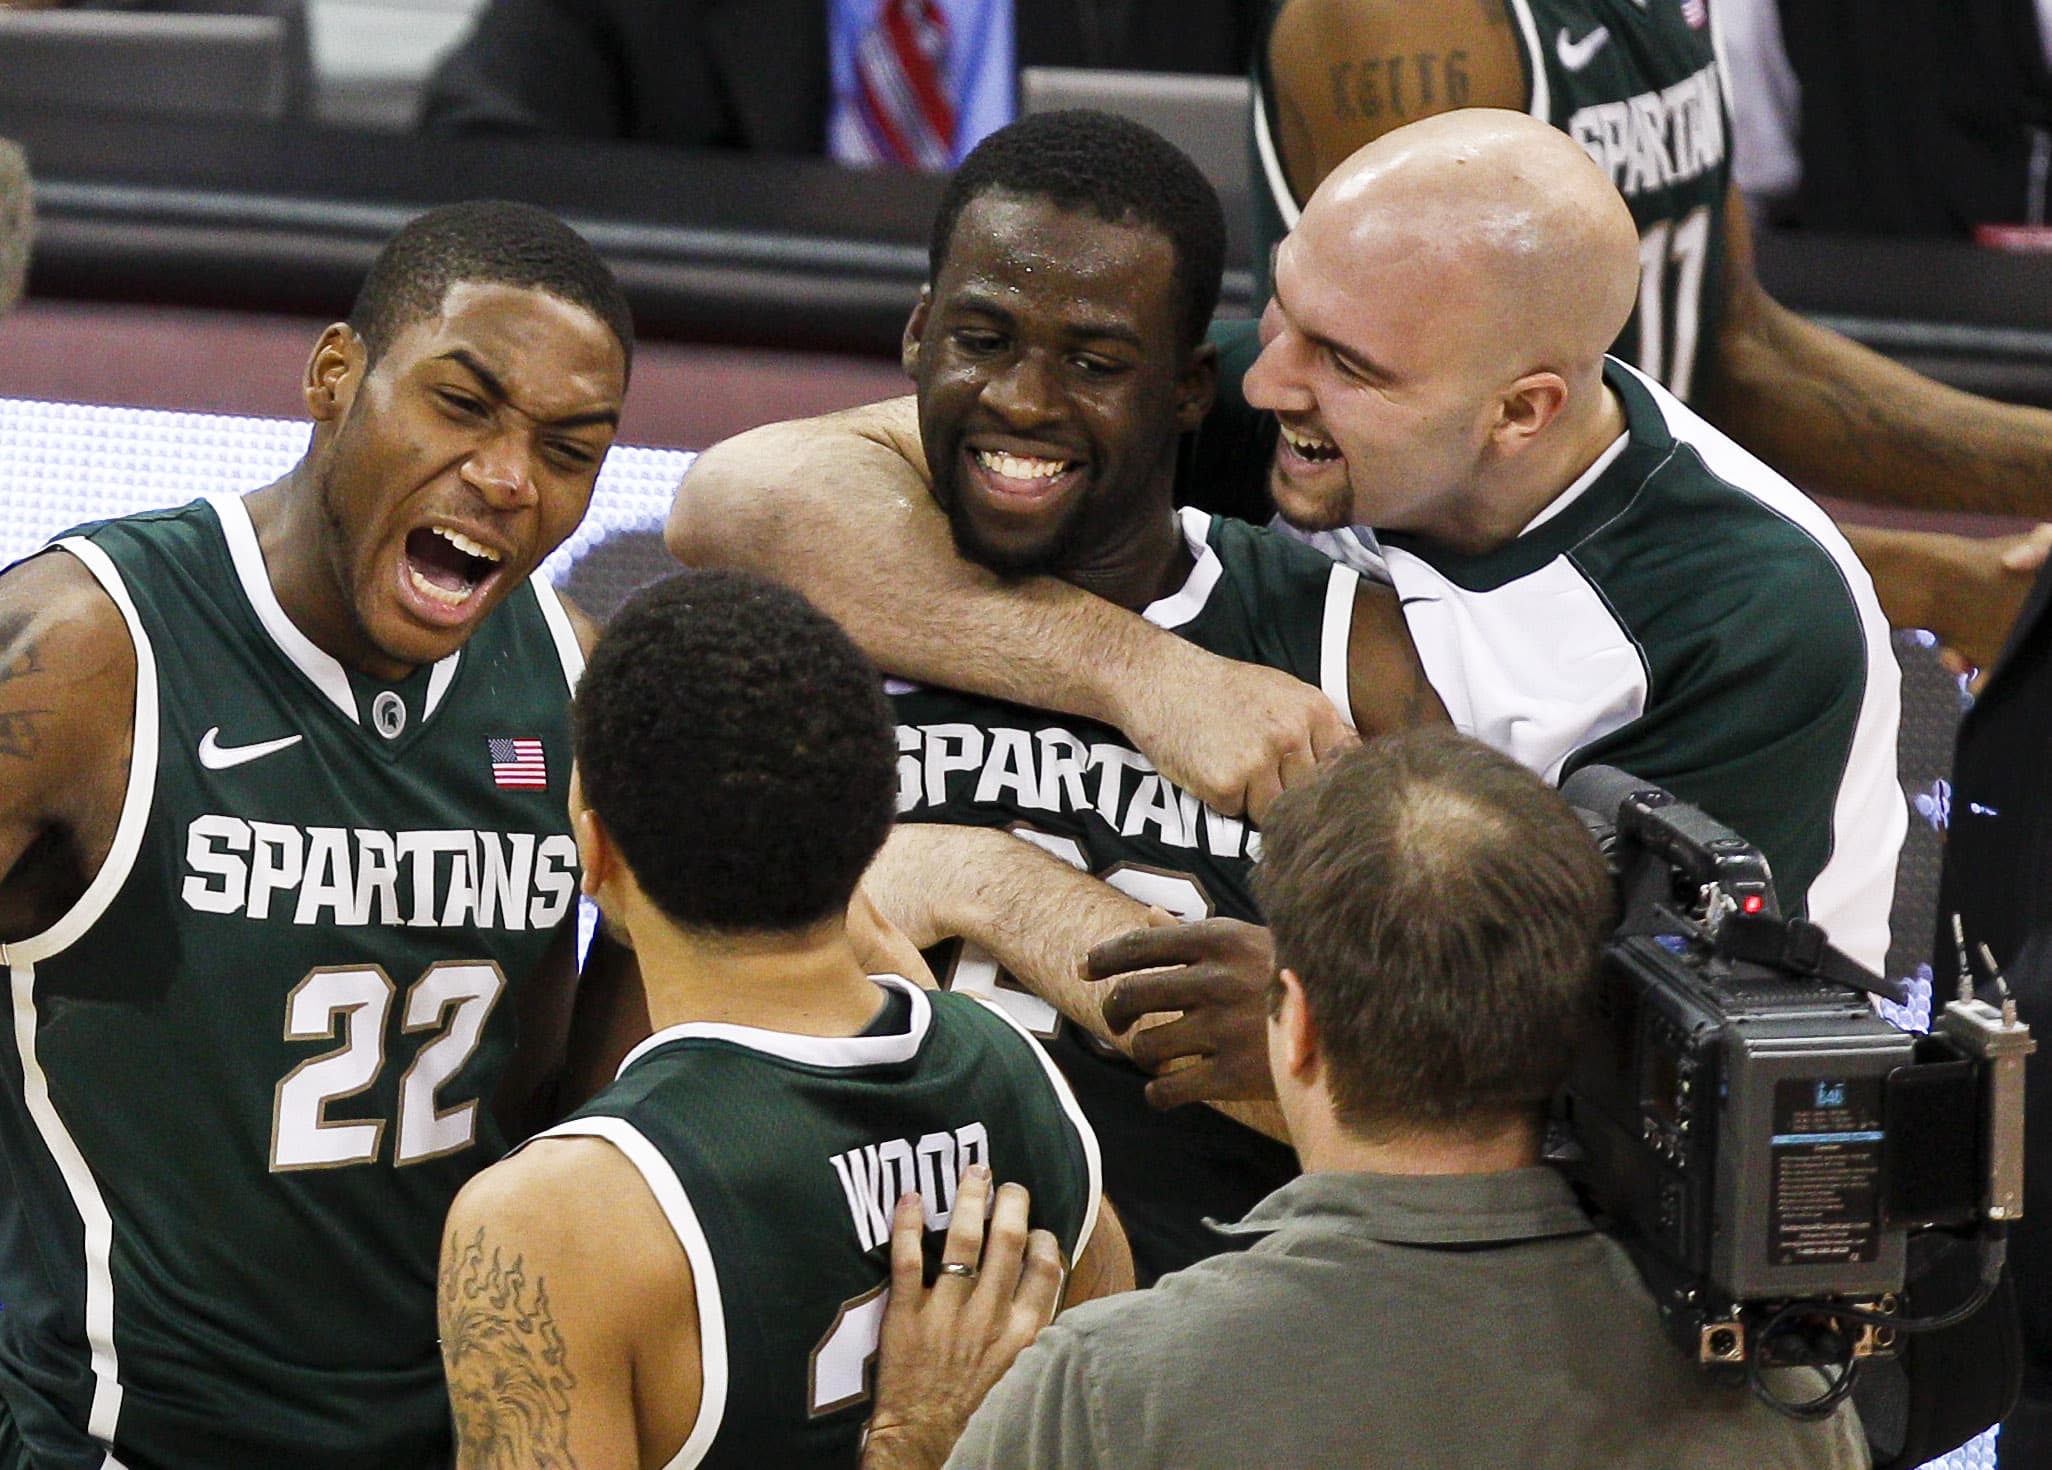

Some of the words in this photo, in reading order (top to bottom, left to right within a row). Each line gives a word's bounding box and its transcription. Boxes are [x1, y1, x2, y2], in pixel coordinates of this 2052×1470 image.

[1639, 207, 1709, 400] 11
[182, 814, 578, 930] SPARTANS
[895, 723, 1263, 863] SPARTAN
[269, 960, 506, 1173] 22
